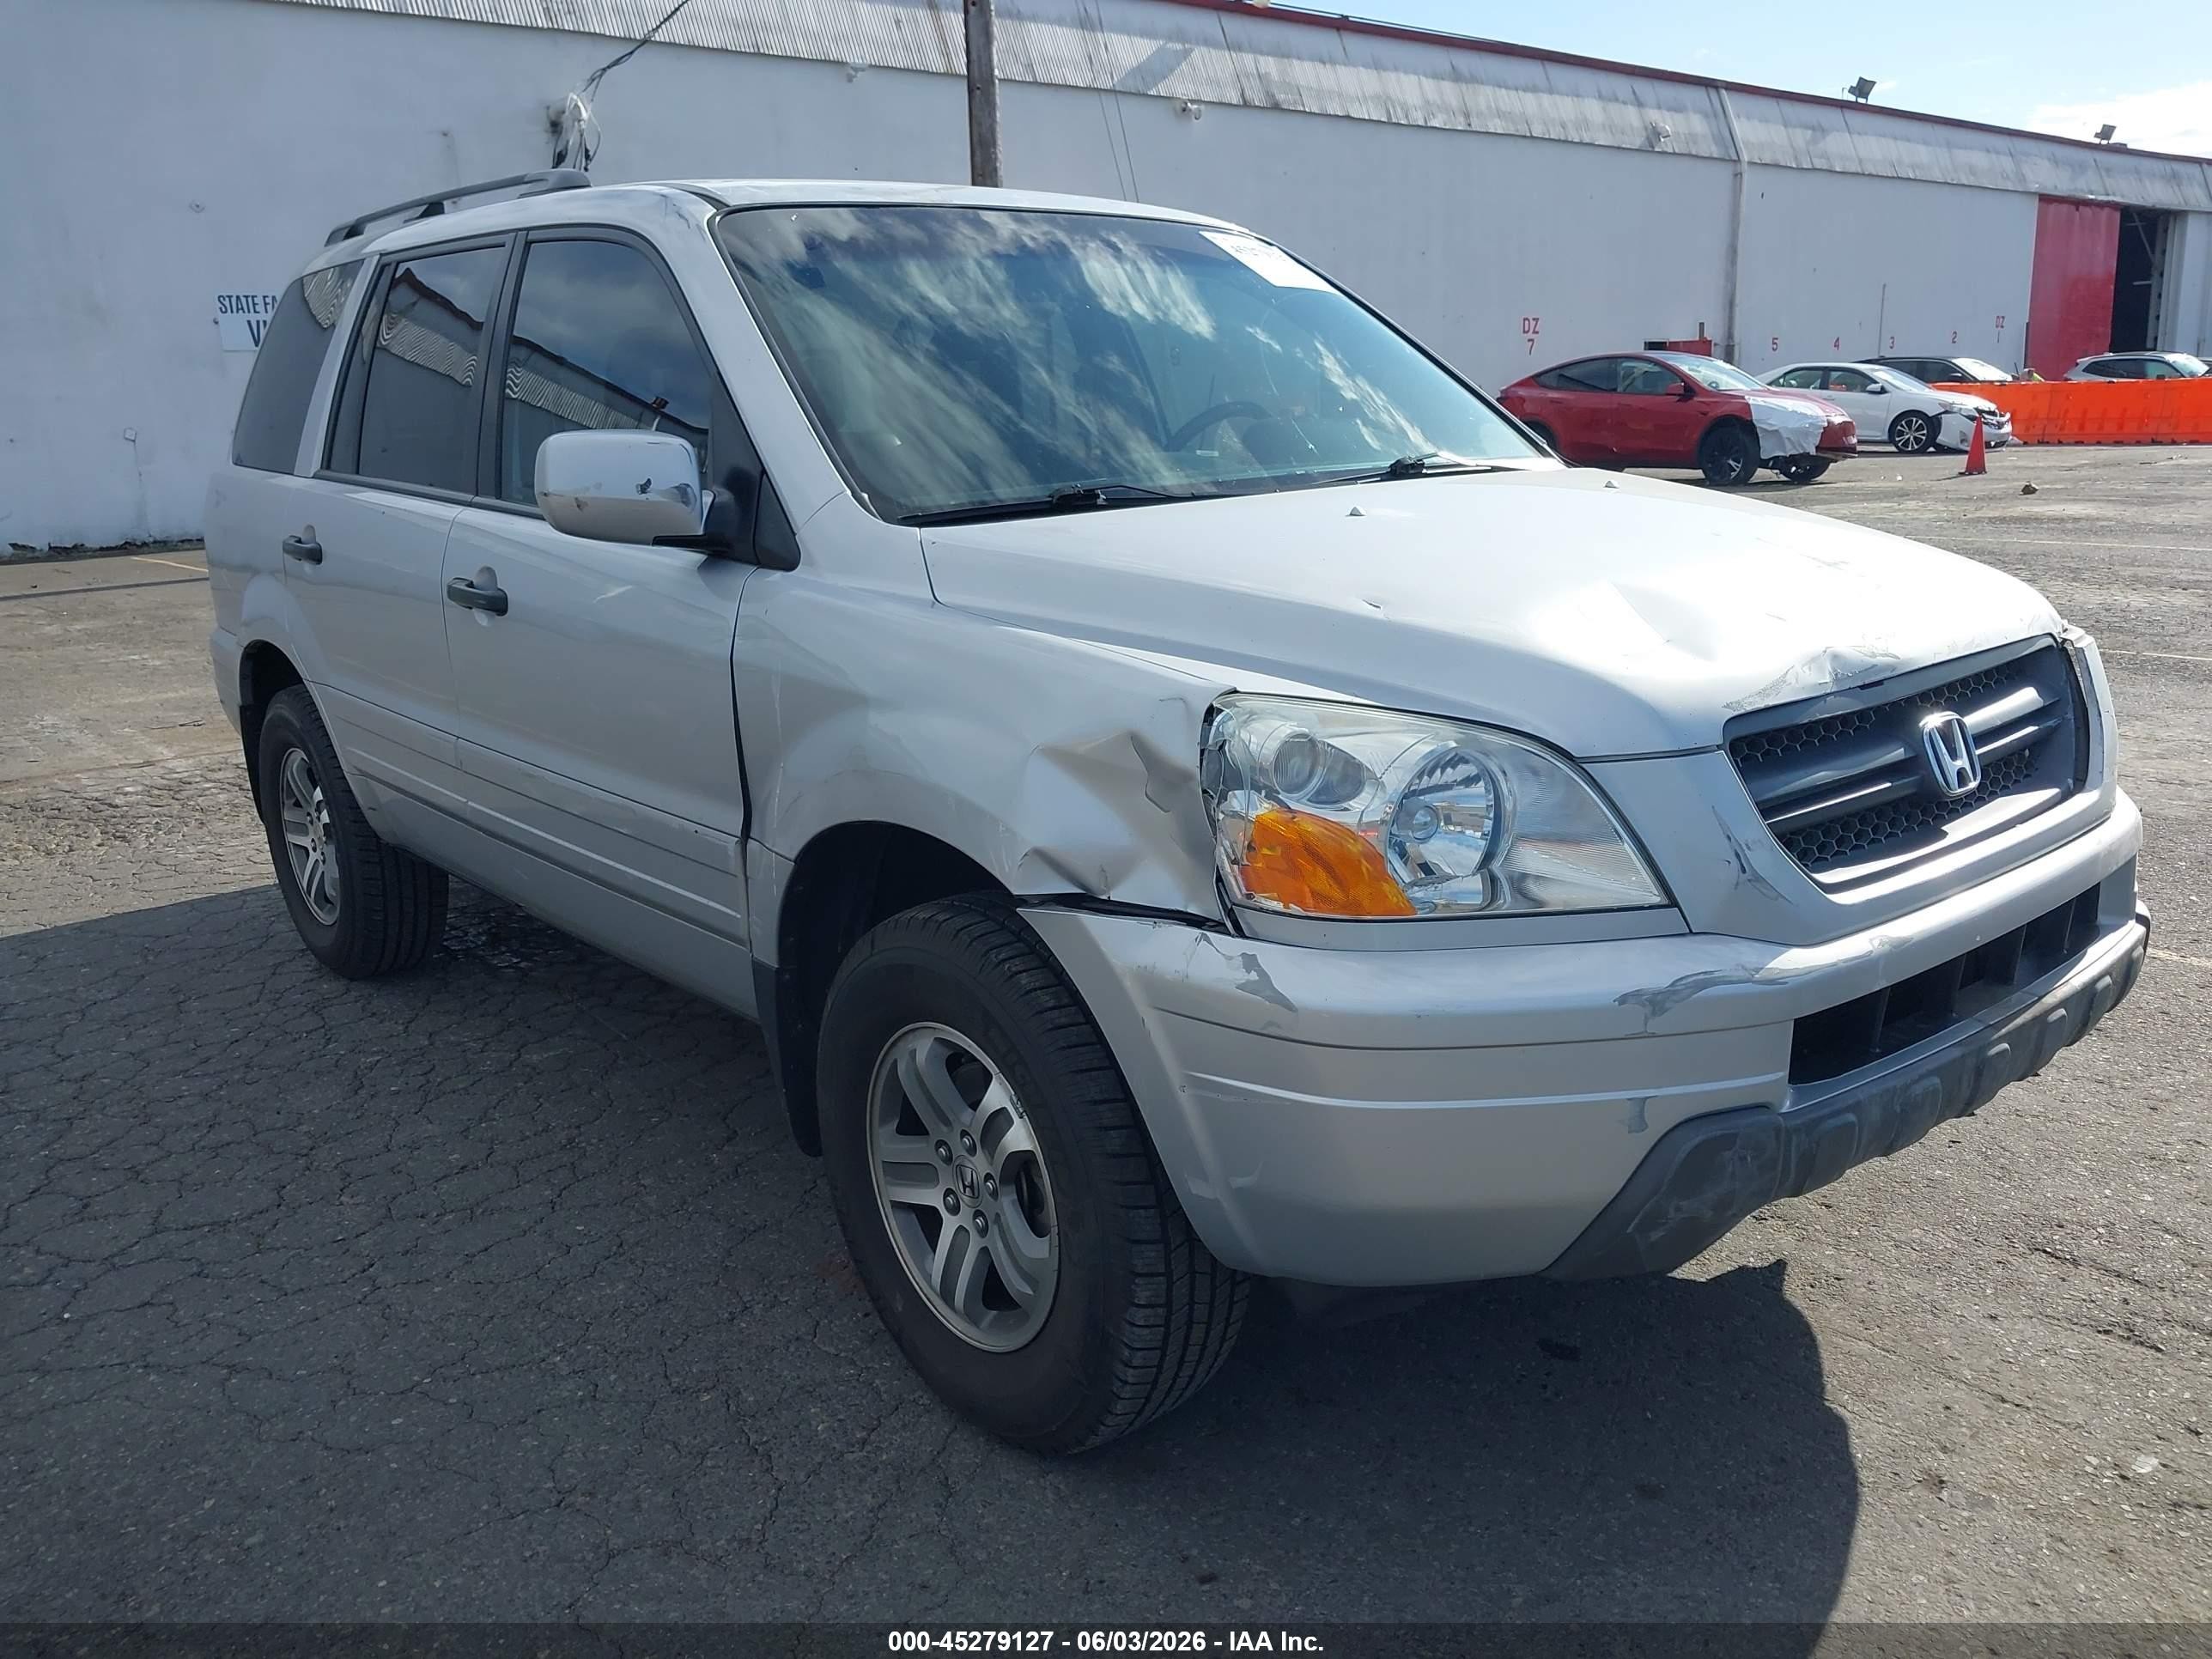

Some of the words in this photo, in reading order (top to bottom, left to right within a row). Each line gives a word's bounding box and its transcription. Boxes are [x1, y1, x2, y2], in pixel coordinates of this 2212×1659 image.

[217, 295, 261, 314] STATE
[1522, 317, 1540, 335] DZ
[1771, 337, 1778, 352] 5
[1833, 336, 1840, 351] 4
[1888, 336, 1895, 349] 3
[1951, 331, 1958, 344] 2
[1527, 338, 1535, 356] 7
